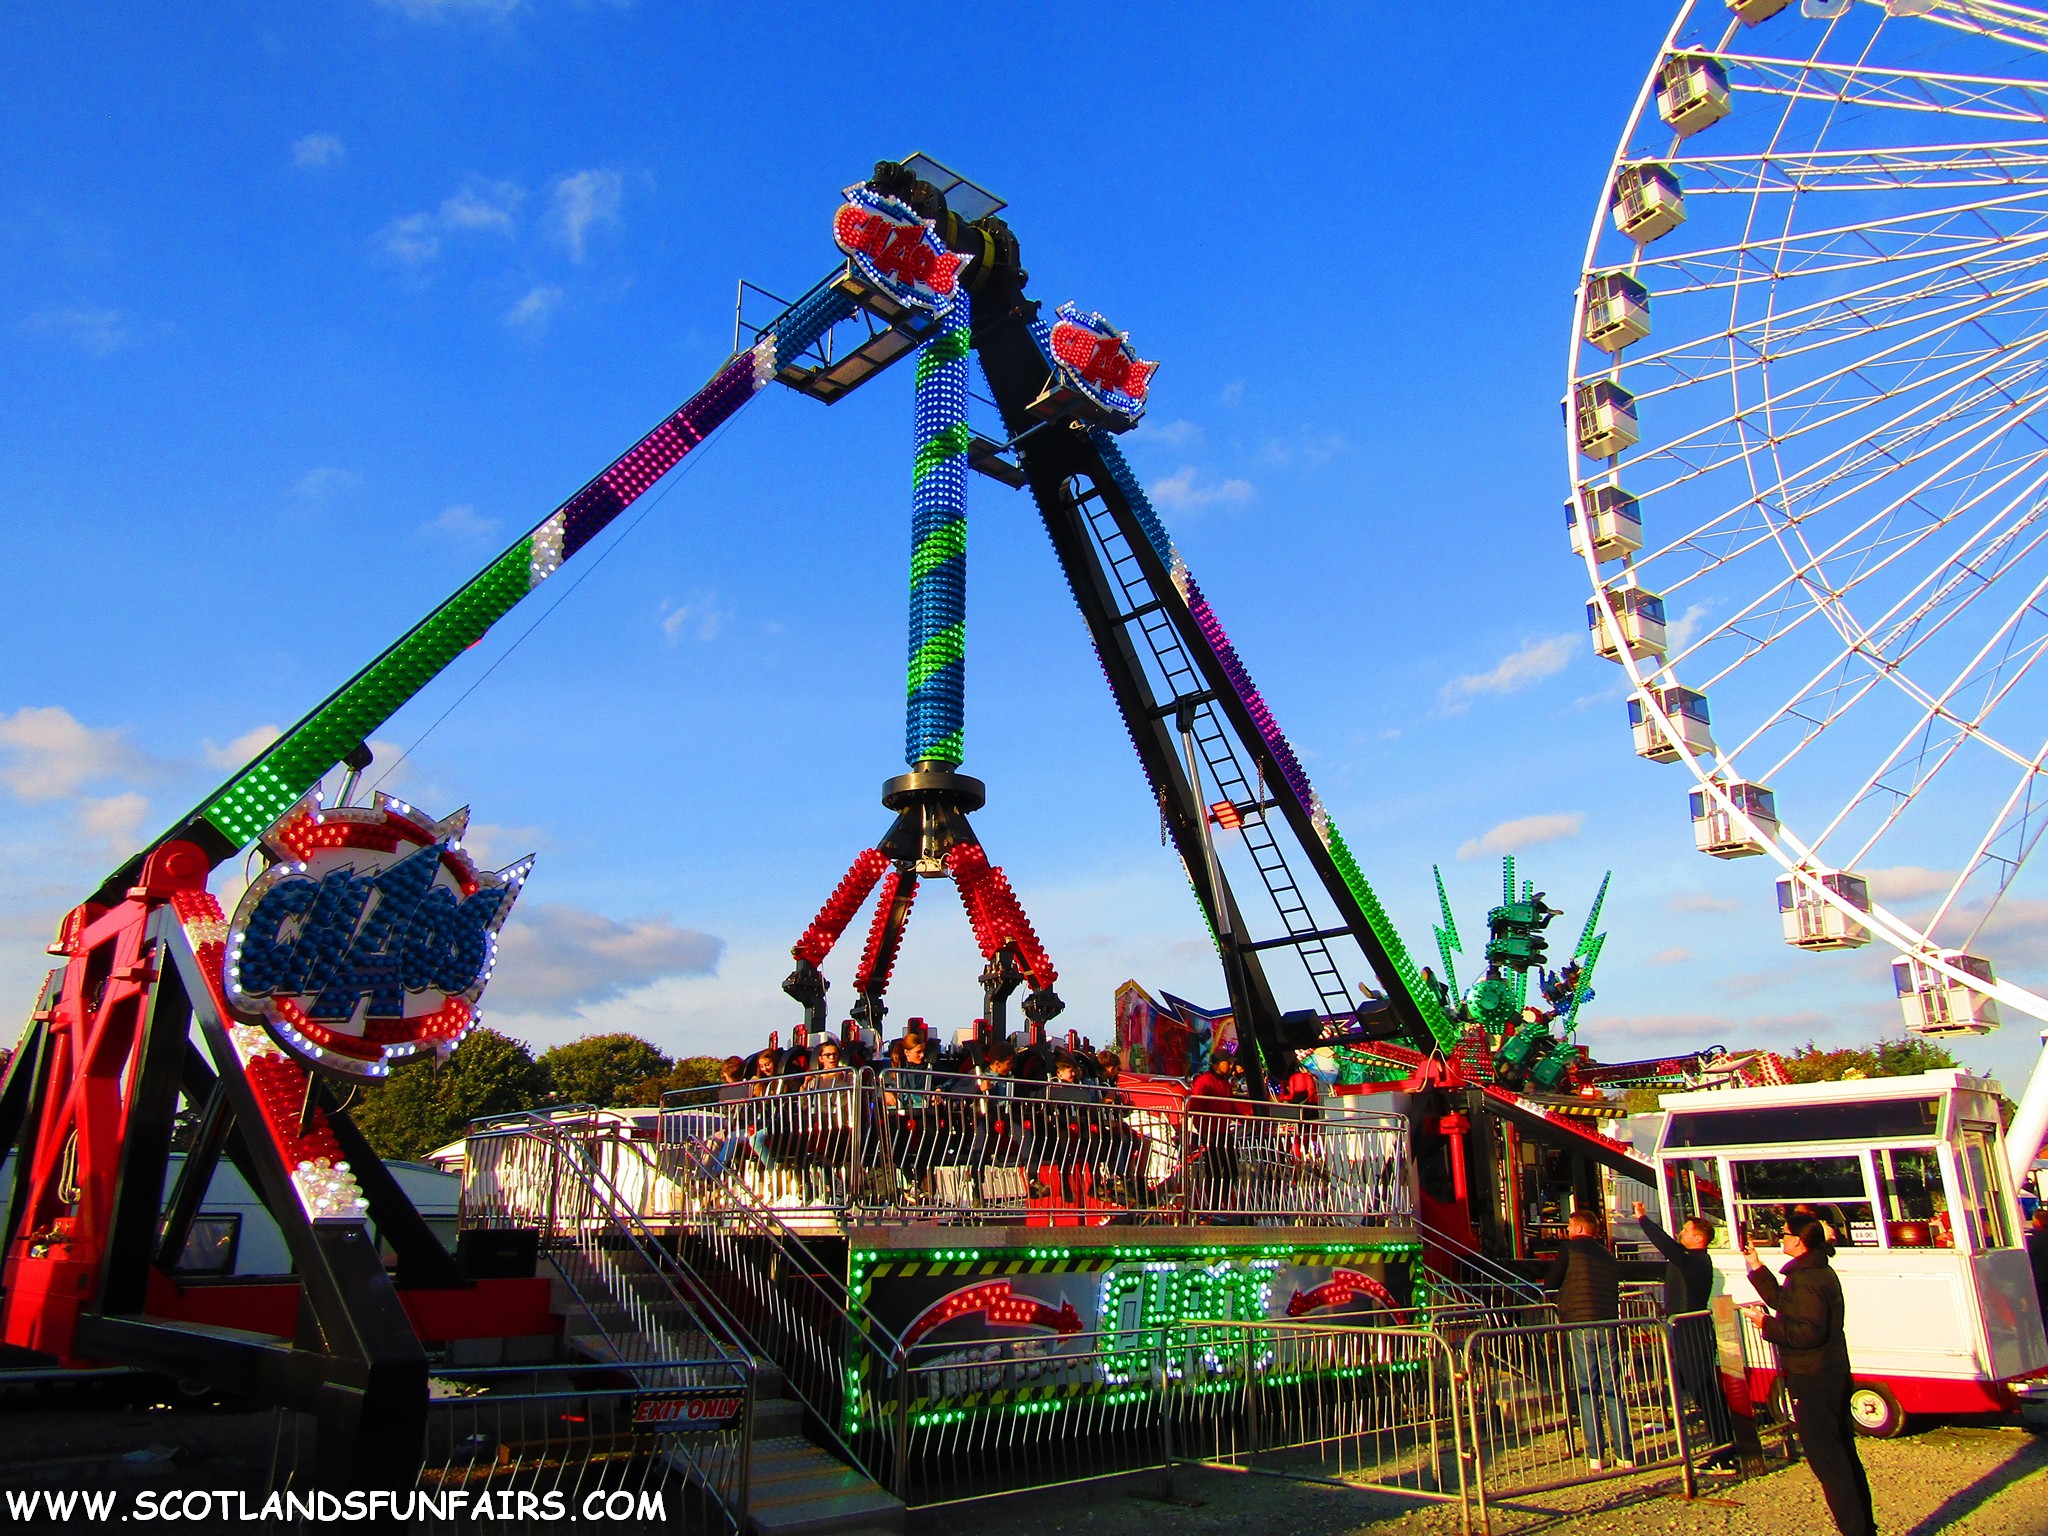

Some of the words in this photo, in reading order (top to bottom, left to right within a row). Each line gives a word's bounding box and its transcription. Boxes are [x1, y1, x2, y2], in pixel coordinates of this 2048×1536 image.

[836, 206, 962, 295] CHAOS
[1051, 324, 1151, 398] CHAOS
[239, 841, 508, 1023] CHAOS
[633, 1401, 687, 1422] EXIT
[688, 1398, 741, 1420] ONLY
